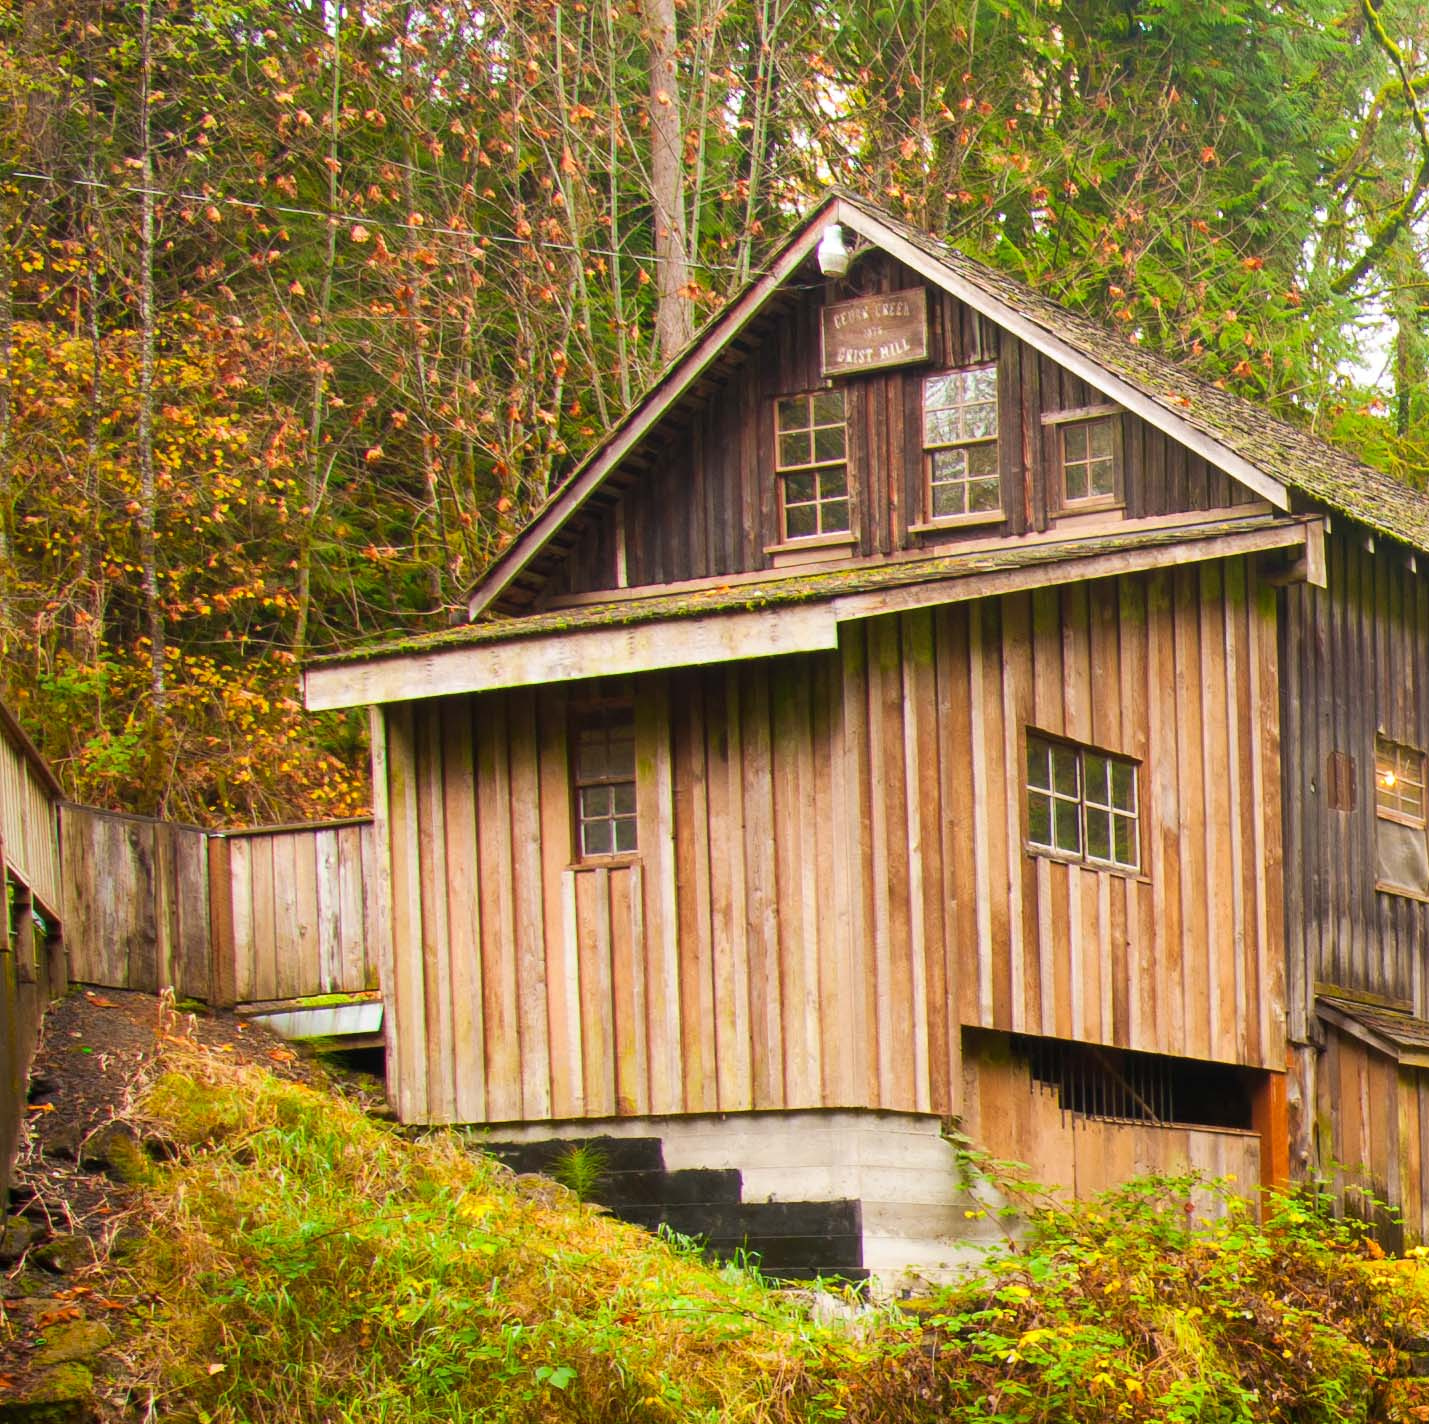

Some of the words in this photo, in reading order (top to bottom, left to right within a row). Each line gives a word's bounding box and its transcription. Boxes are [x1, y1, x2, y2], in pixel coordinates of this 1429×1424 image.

[875, 302, 911, 317] CREEK
[837, 347, 873, 363] GRIST
[880, 339, 911, 359] MILL
